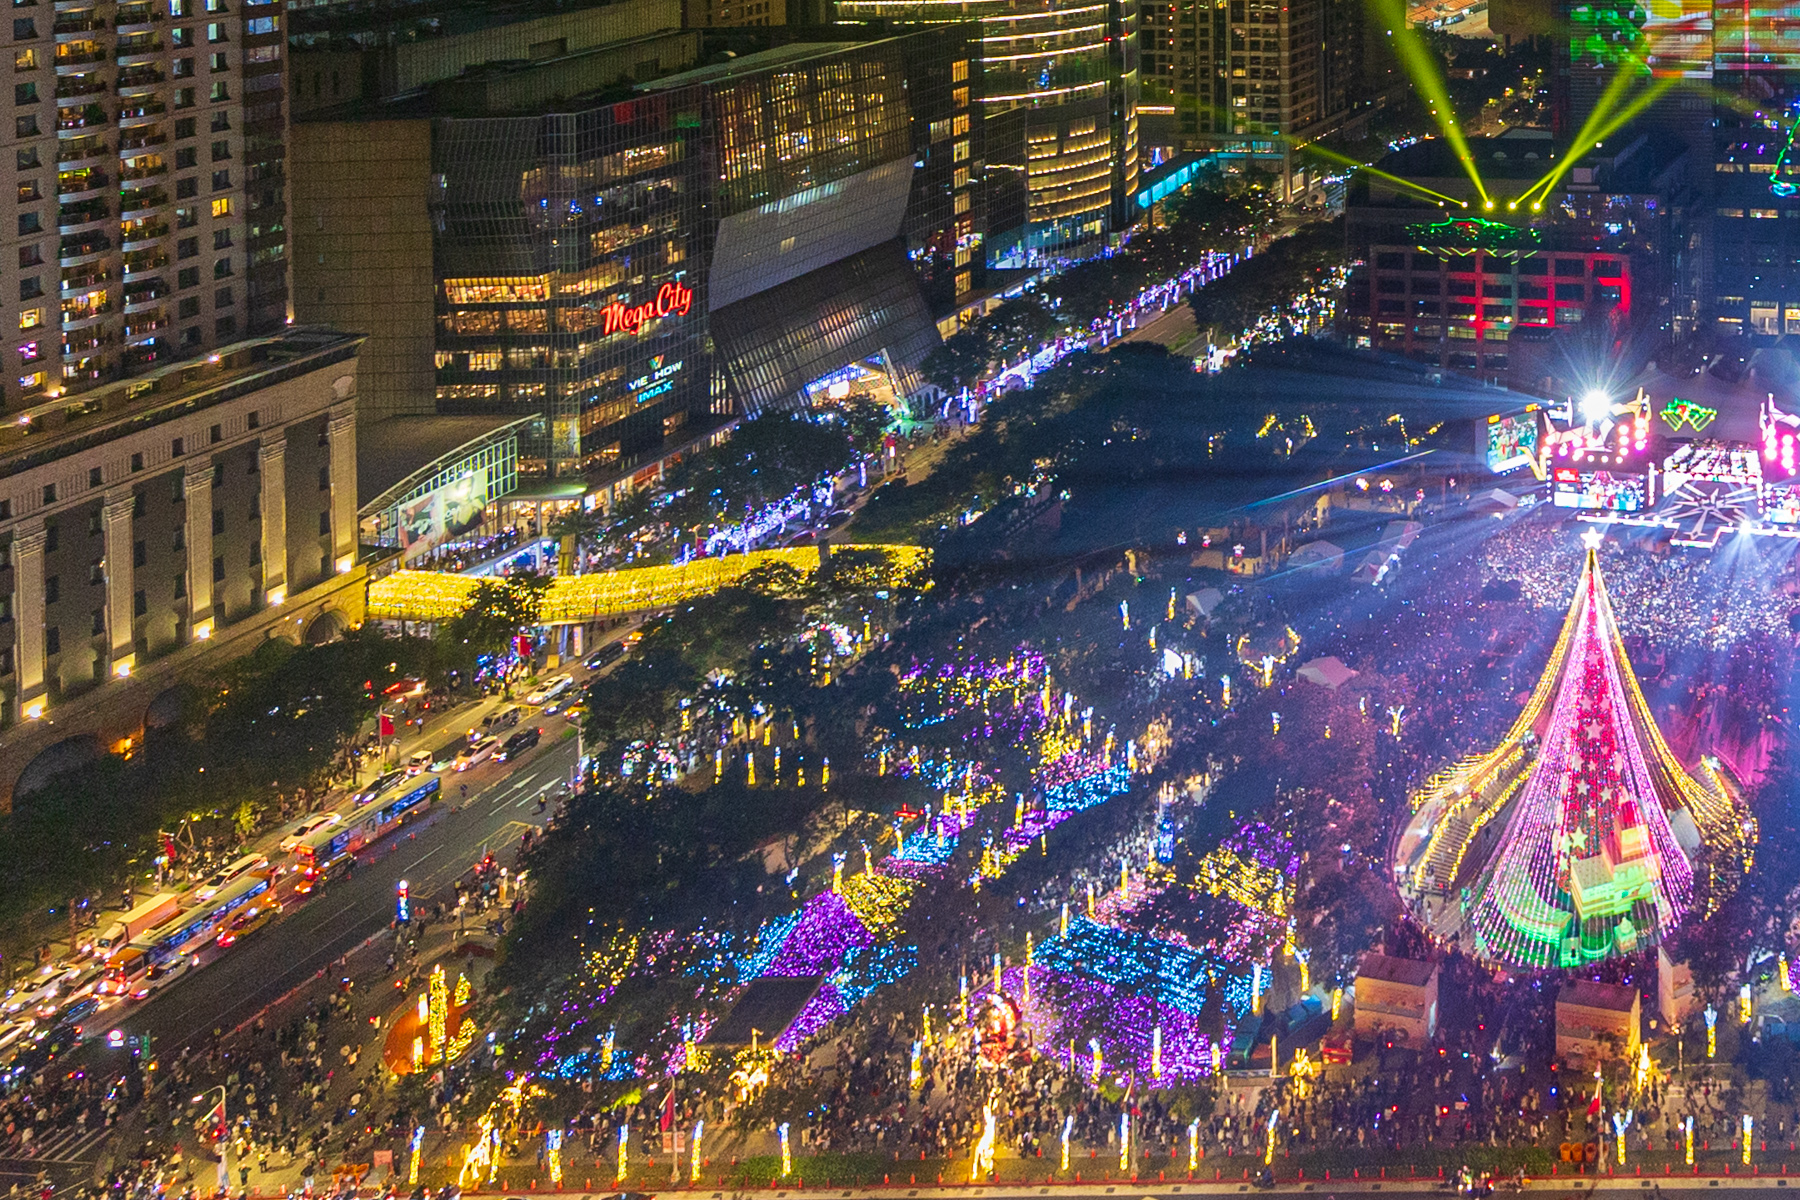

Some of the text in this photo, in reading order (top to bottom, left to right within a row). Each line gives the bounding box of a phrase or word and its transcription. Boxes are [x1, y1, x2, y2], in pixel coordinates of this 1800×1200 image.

[600, 281, 693, 336] Mega City
[627, 360, 683, 391] VIEHOW
[637, 382, 673, 403] IMAX
